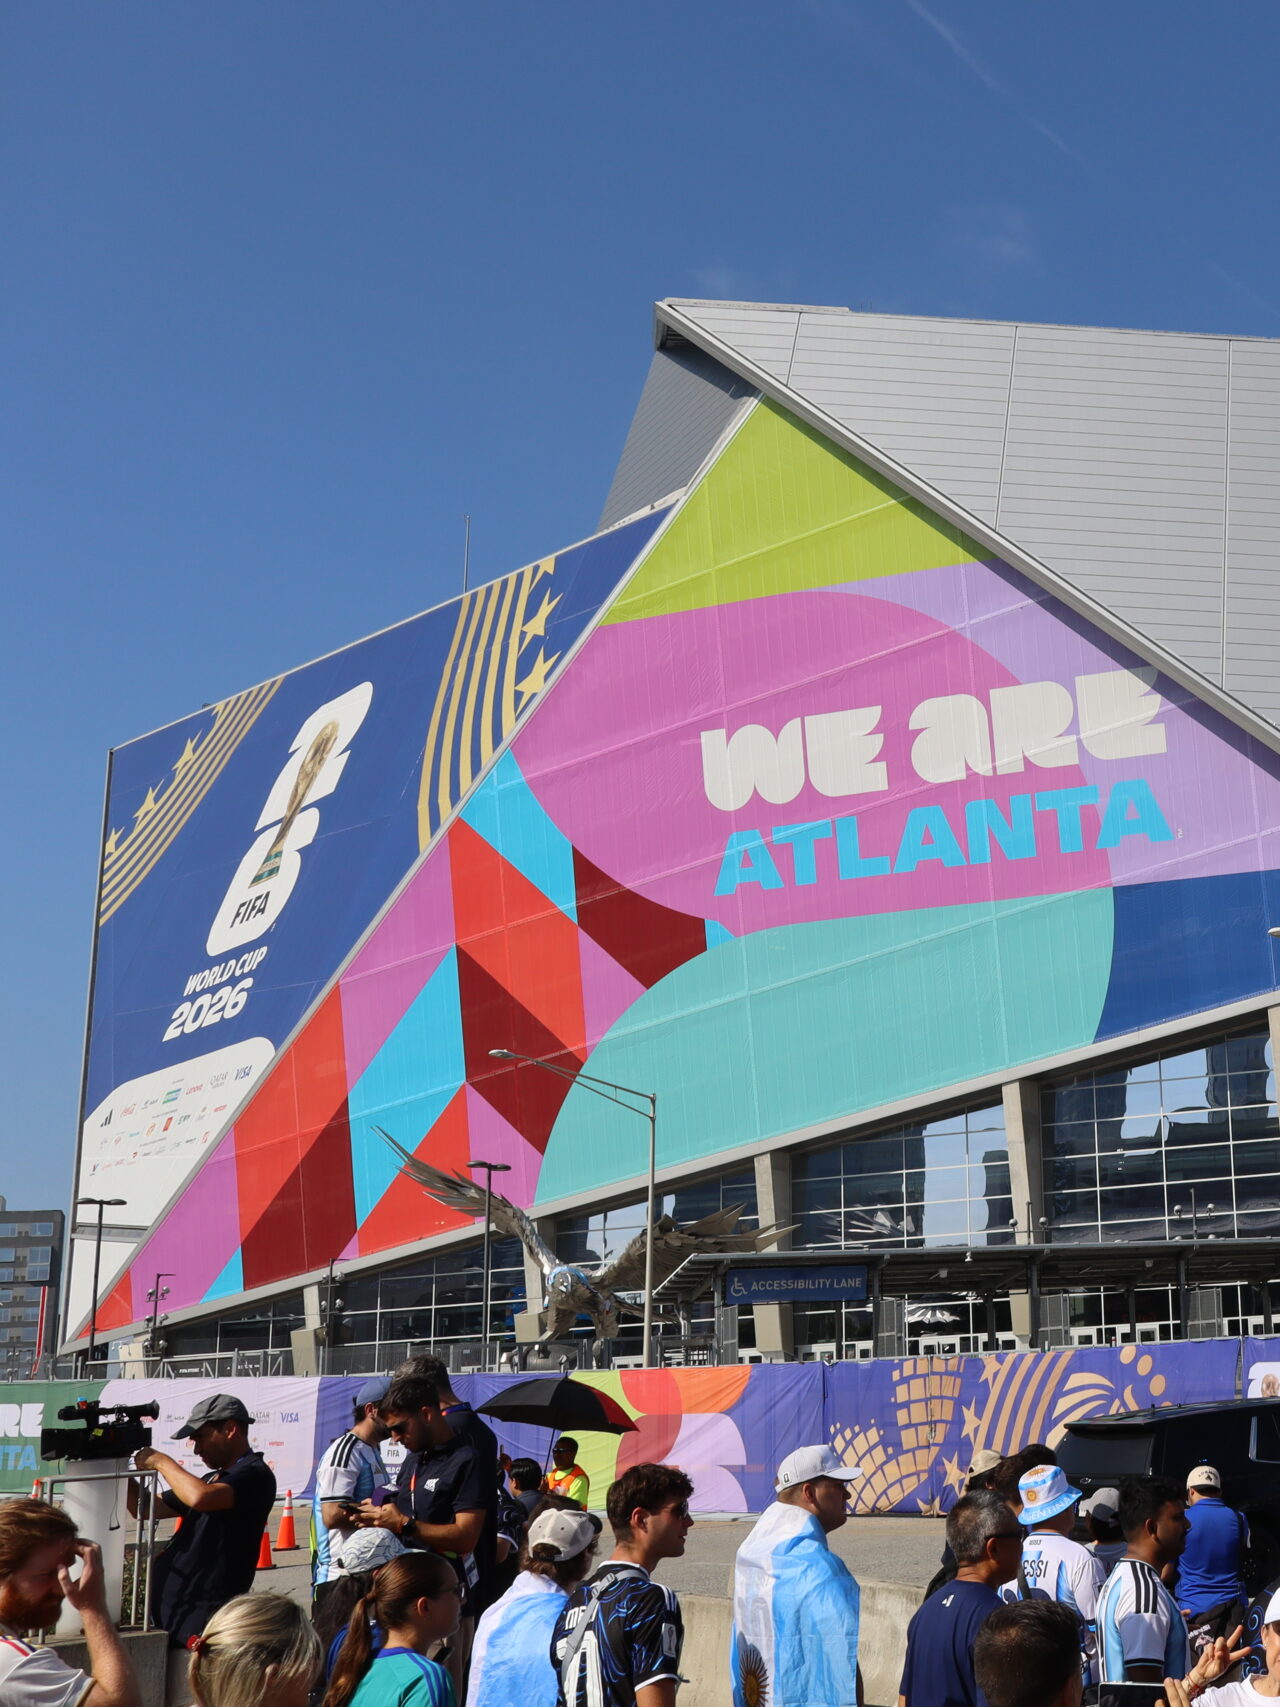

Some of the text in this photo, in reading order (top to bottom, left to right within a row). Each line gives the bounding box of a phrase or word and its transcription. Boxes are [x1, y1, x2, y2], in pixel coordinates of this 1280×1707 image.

[700, 705, 889, 812] WE
[713, 778, 1175, 897] ATLANTA
[229, 890, 271, 929] FIFA
[182, 945, 268, 998] WORLD CUP
[161, 977, 254, 1043] 2026
[234, 1064, 253, 1081] VISA
[751, 1277, 862, 1291] ACCESSIBILITY LANE
[280, 1411, 300, 1424] VISA
[387, 1450, 400, 1458] FIFA
[1023, 1560, 1048, 1579] ESSI
